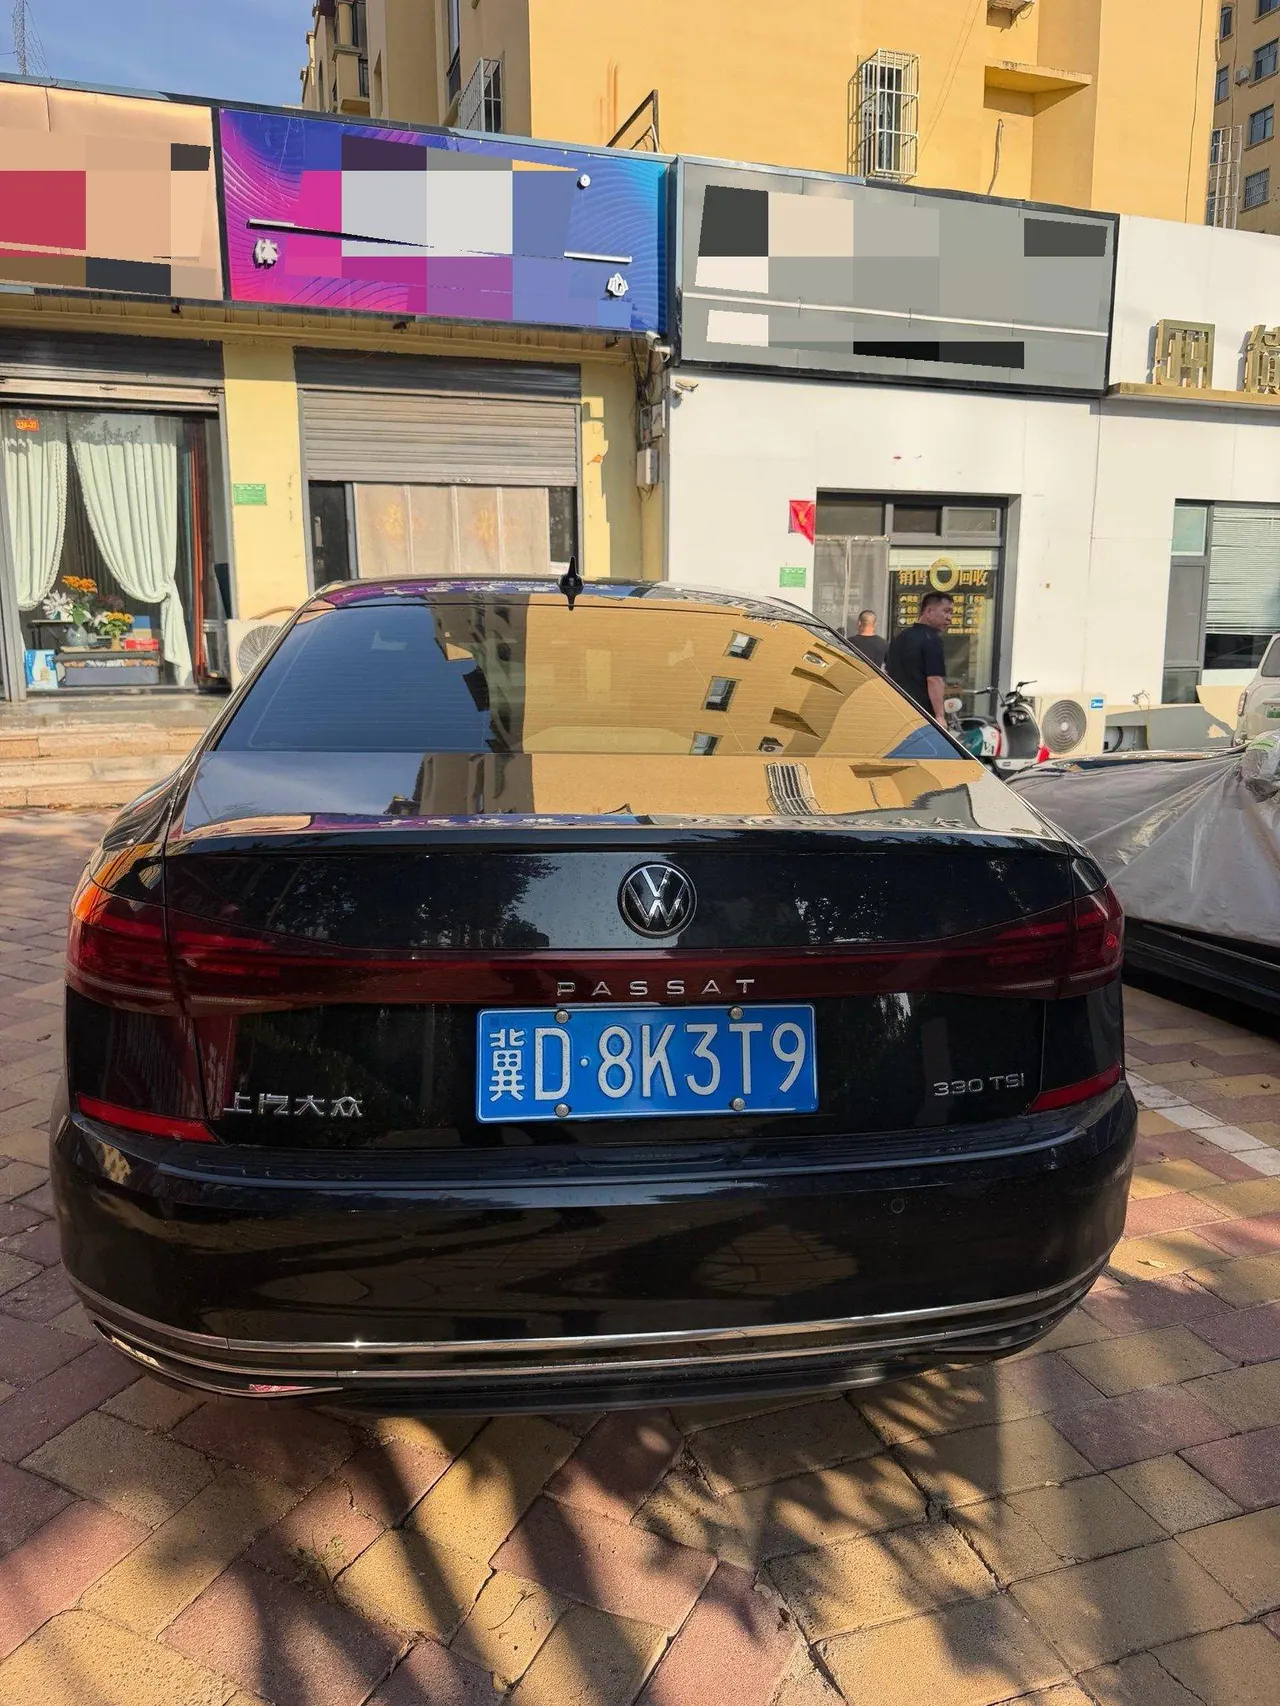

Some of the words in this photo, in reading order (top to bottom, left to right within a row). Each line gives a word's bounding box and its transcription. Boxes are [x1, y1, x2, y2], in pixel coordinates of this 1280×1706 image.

[959, 568, 989, 587] 回收
[557, 978, 756, 997] PASSAT
[933, 1077, 984, 1097] 330
[989, 1072, 1025, 1091] TSI
[223, 1091, 364, 1118] 上汽大众
